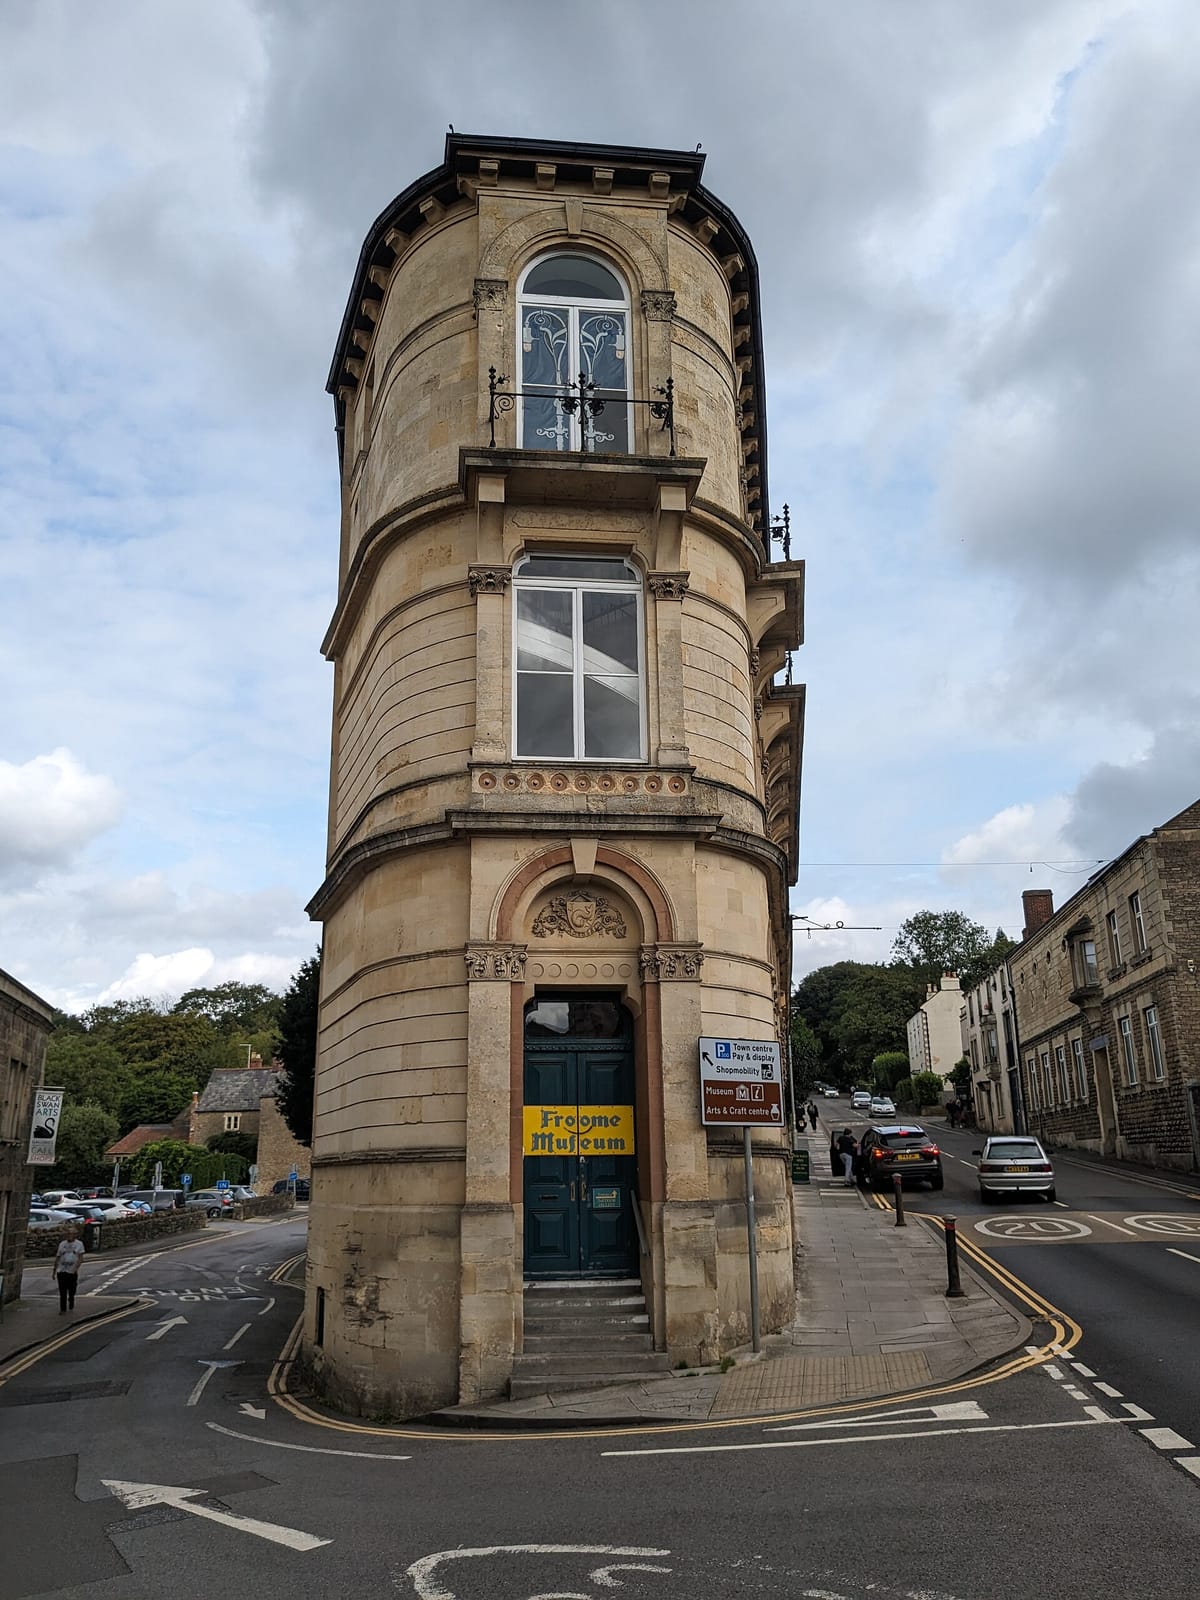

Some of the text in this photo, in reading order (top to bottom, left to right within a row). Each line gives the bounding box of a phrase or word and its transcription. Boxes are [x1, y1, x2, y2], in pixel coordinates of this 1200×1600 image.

[733, 1043, 773, 1053] Town centre
[732, 1052, 745, 1062] Pay
[752, 1054, 775, 1063] display
[716, 1065, 760, 1076] Shopmobility
[706, 1087, 734, 1095] Museum
[35, 1108, 59, 1116] ARTS
[706, 1106, 721, 1115] Arts
[729, 1106, 747, 1115] Craft
[748, 1108, 769, 1116] centre
[540, 1108, 621, 1128] Froome
[994, 1221, 1071, 1235] 20
[138, 1286, 246, 1296] ENTRY
